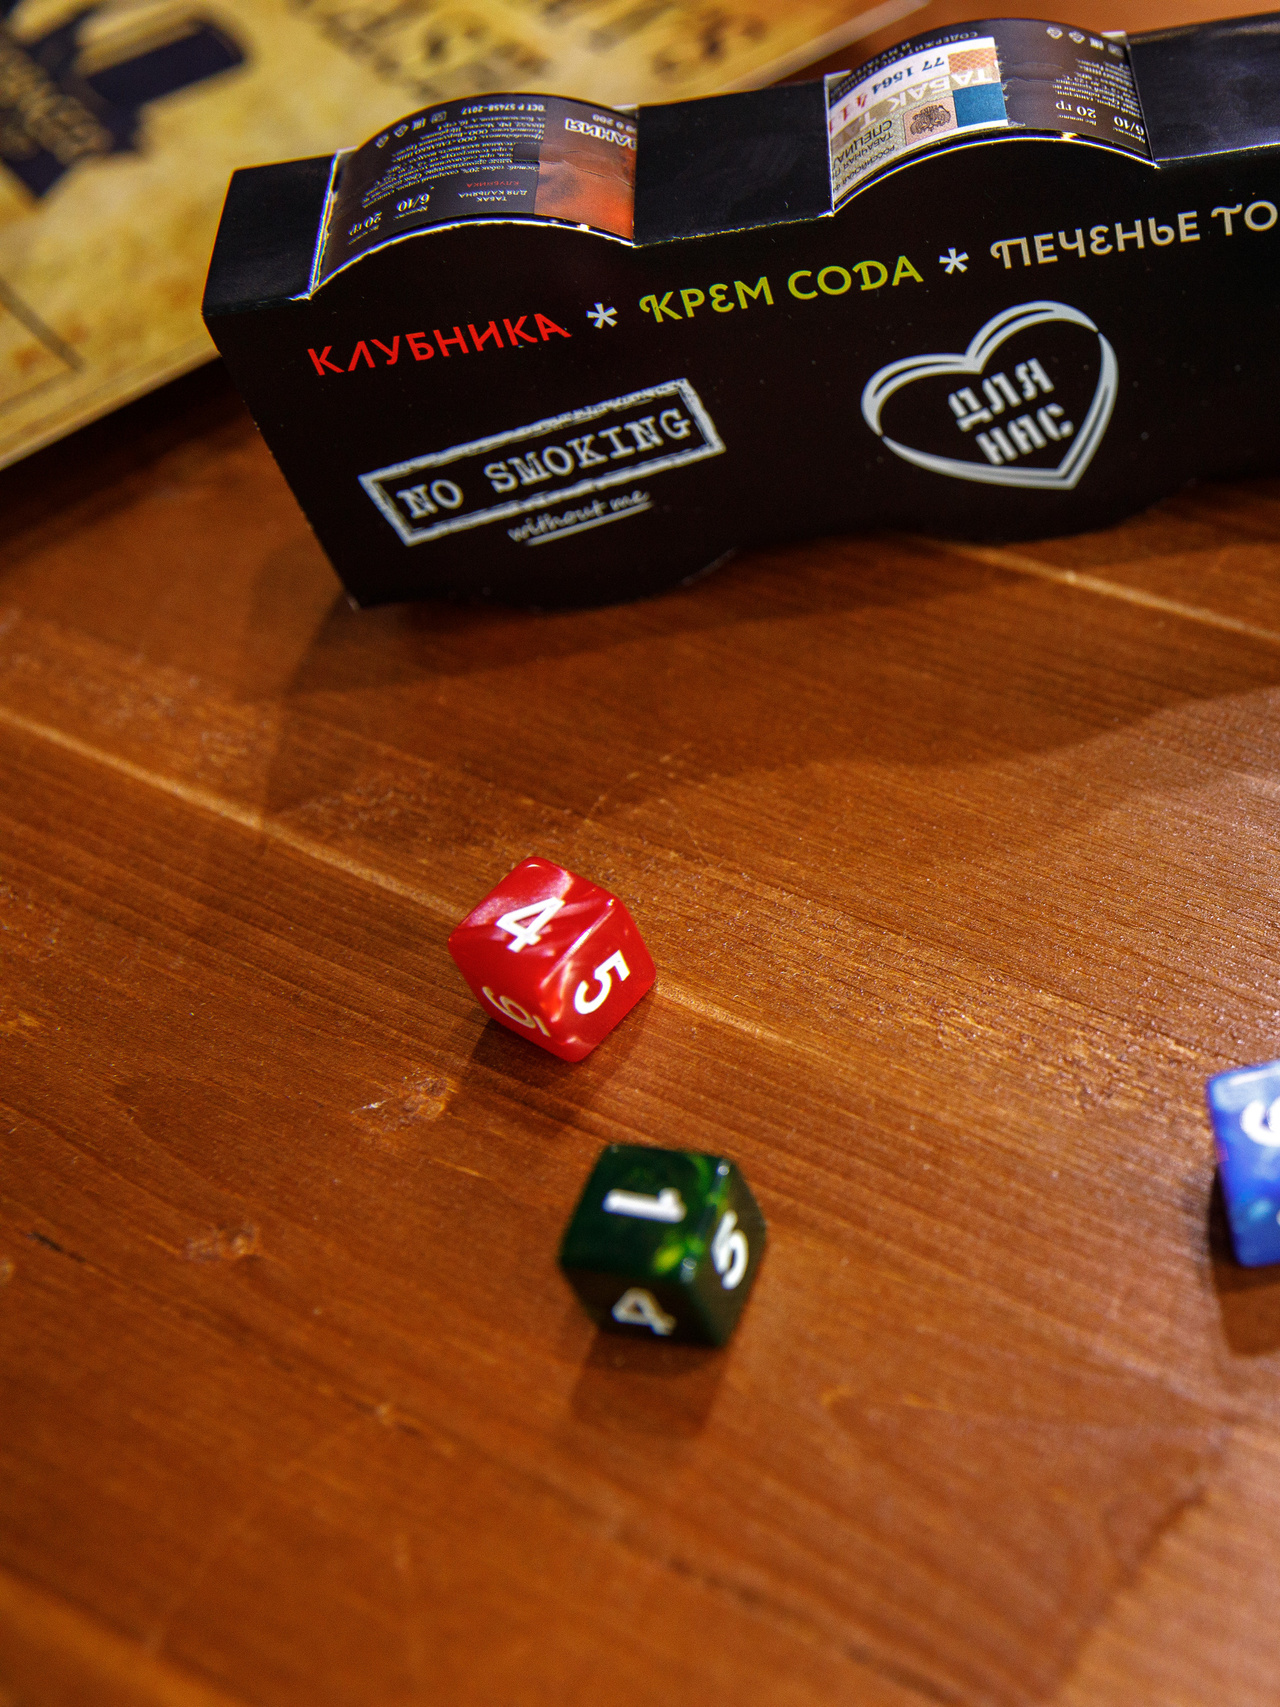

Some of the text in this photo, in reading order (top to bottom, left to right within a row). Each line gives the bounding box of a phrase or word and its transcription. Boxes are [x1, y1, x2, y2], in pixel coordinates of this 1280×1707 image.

[908, 31, 978, 55] СОДЕРЖИТ
[872, 66, 913, 95] 1564
[922, 57, 945, 72] 77
[461, 103, 516, 115] 57458-2017
[886, 69, 993, 113] ТАБАК
[1055, 100, 1097, 119] 20 гр
[1113, 115, 1144, 136] 6/10
[457, 135, 478, 143] ООО
[467, 128, 488, 136] ООО
[842, 145, 895, 185] РОССИЙСКАЯ
[843, 132, 893, 169] ТАБАЧНАЯ
[396, 193, 430, 212] 6/10
[458, 189, 505, 198] КАЛЬЯНА
[466, 181, 519, 189] КЛУБНИКА
[347, 211, 382, 236] 20 гр
[990, 210, 1200, 270] ПЕЧЕНЬЕ
[639, 276, 774, 323] КРЕМ
[307, 313, 572, 376] КЛУБНИКА
[947, 357, 1055, 432] ДЛЯ
[396, 408, 692, 519] NO SMOKING
[507, 500, 606, 543] without
[495, 896, 566, 953] 4
[574, 949, 631, 1015] 5
[602, 1187, 687, 1223] 1
[611, 1287, 677, 1336] 4
